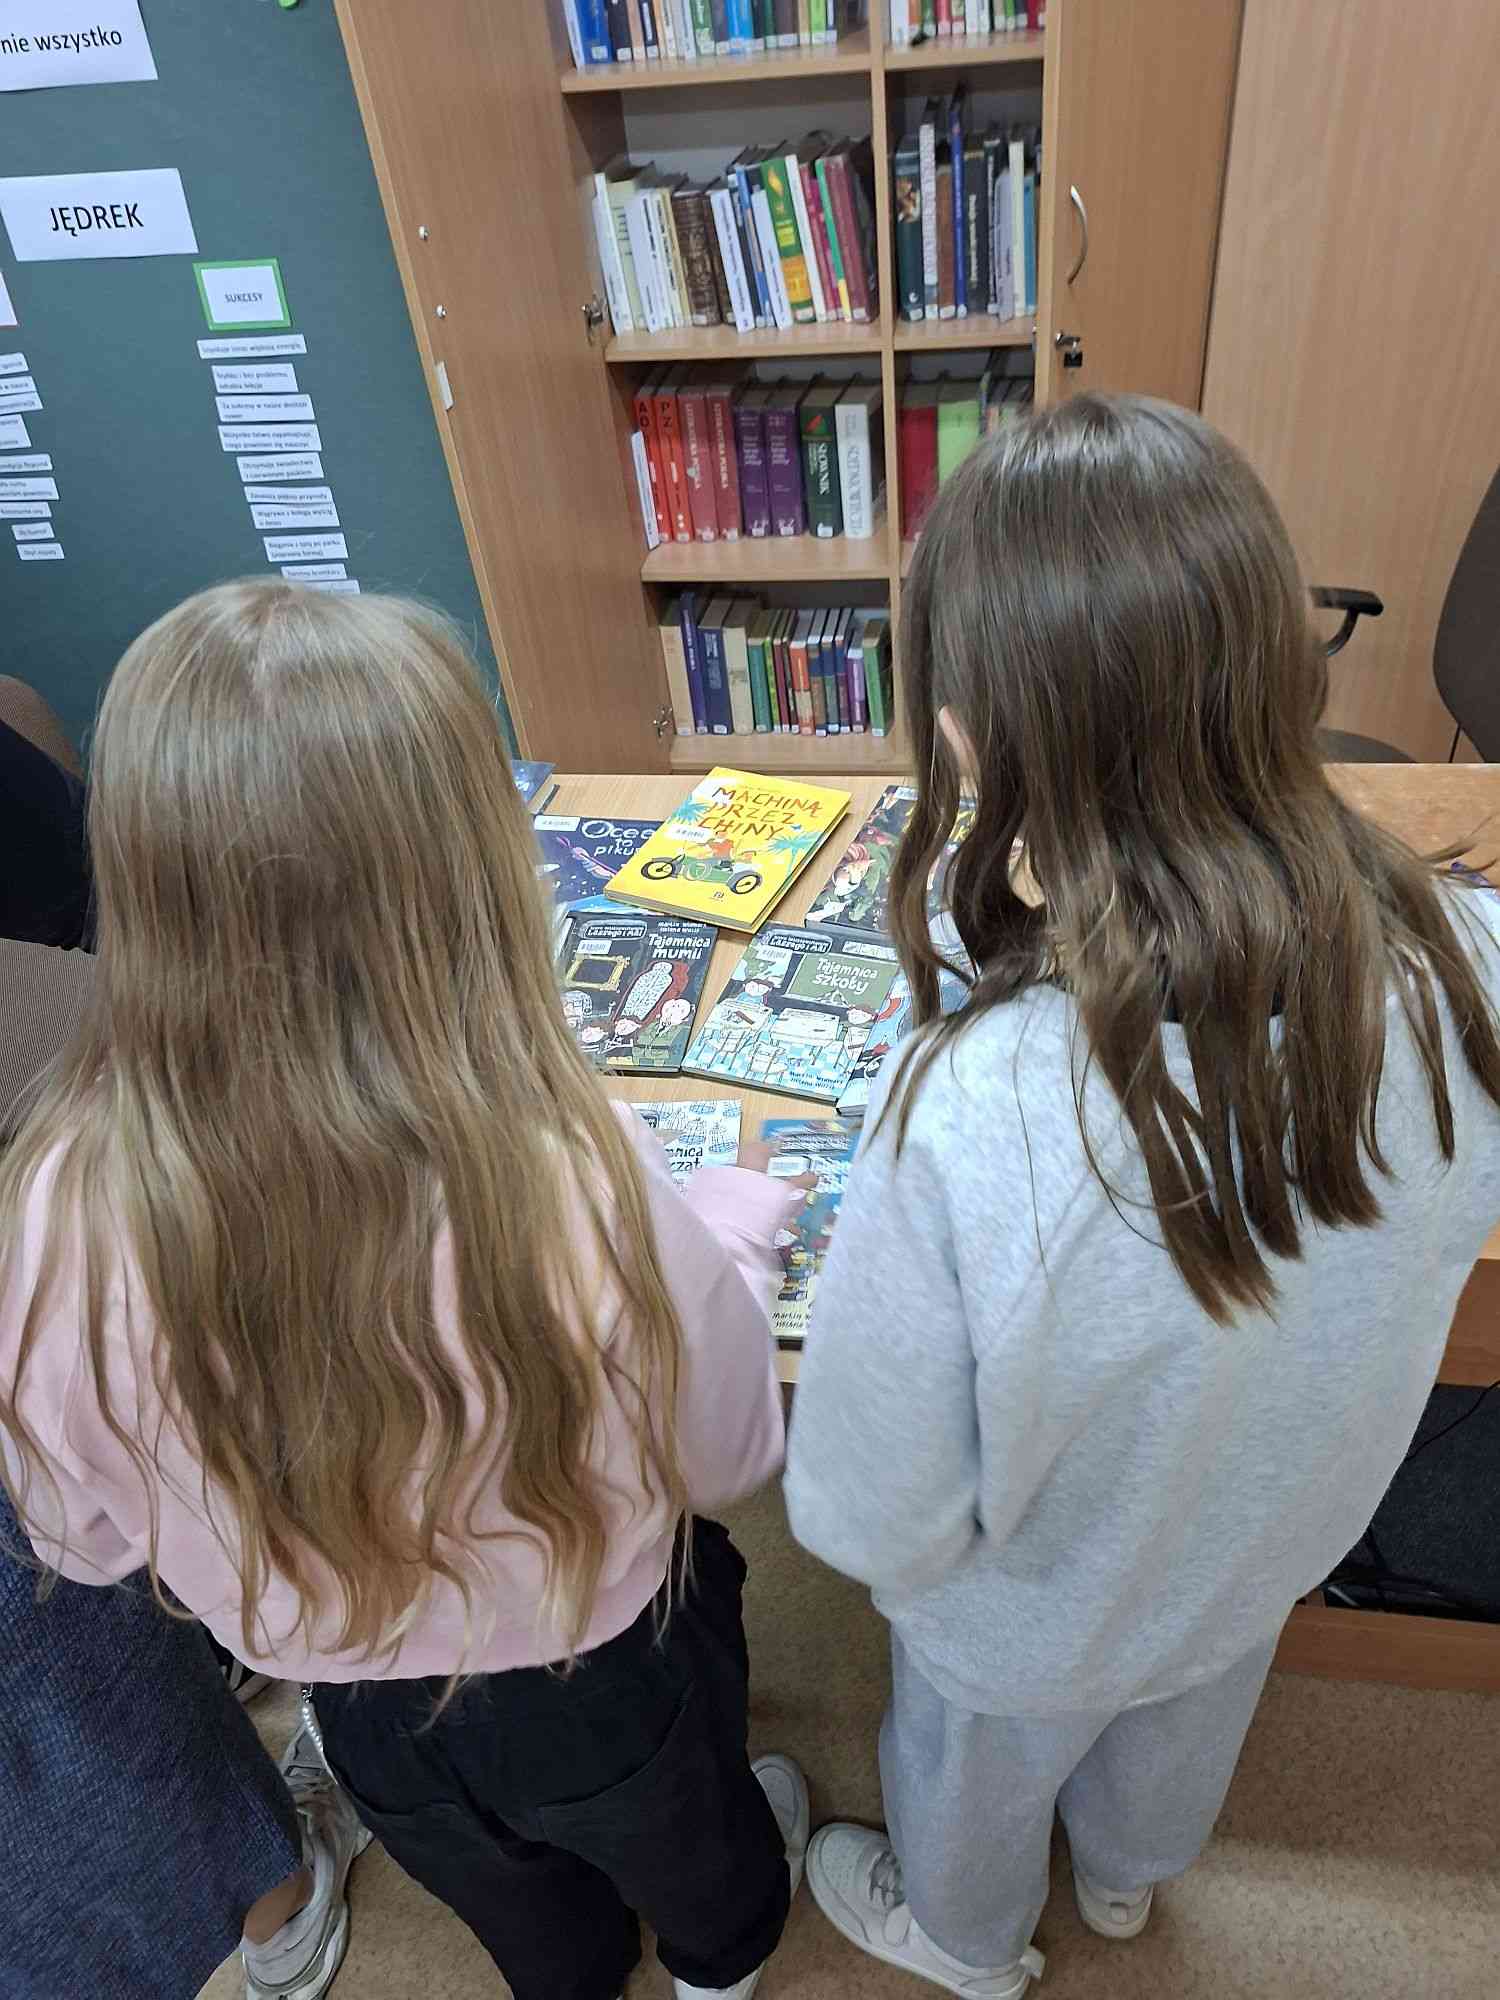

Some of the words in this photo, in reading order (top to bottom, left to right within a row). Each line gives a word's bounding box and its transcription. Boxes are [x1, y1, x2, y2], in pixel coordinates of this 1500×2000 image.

[1, 33, 29, 54] nie
[34, 26, 123, 53] wszystko
[51, 203, 145, 237] JĘDREK
[703, 801, 796, 825] PRZEZ
[711, 786, 824, 818] MACHINĄ
[698, 816, 785, 841] CHINY
[648, 933, 711, 949] Tajemnica
[652, 946, 703, 960] mumii
[816, 958, 878, 979] Tajemnica
[812, 973, 869, 995] szkoły
